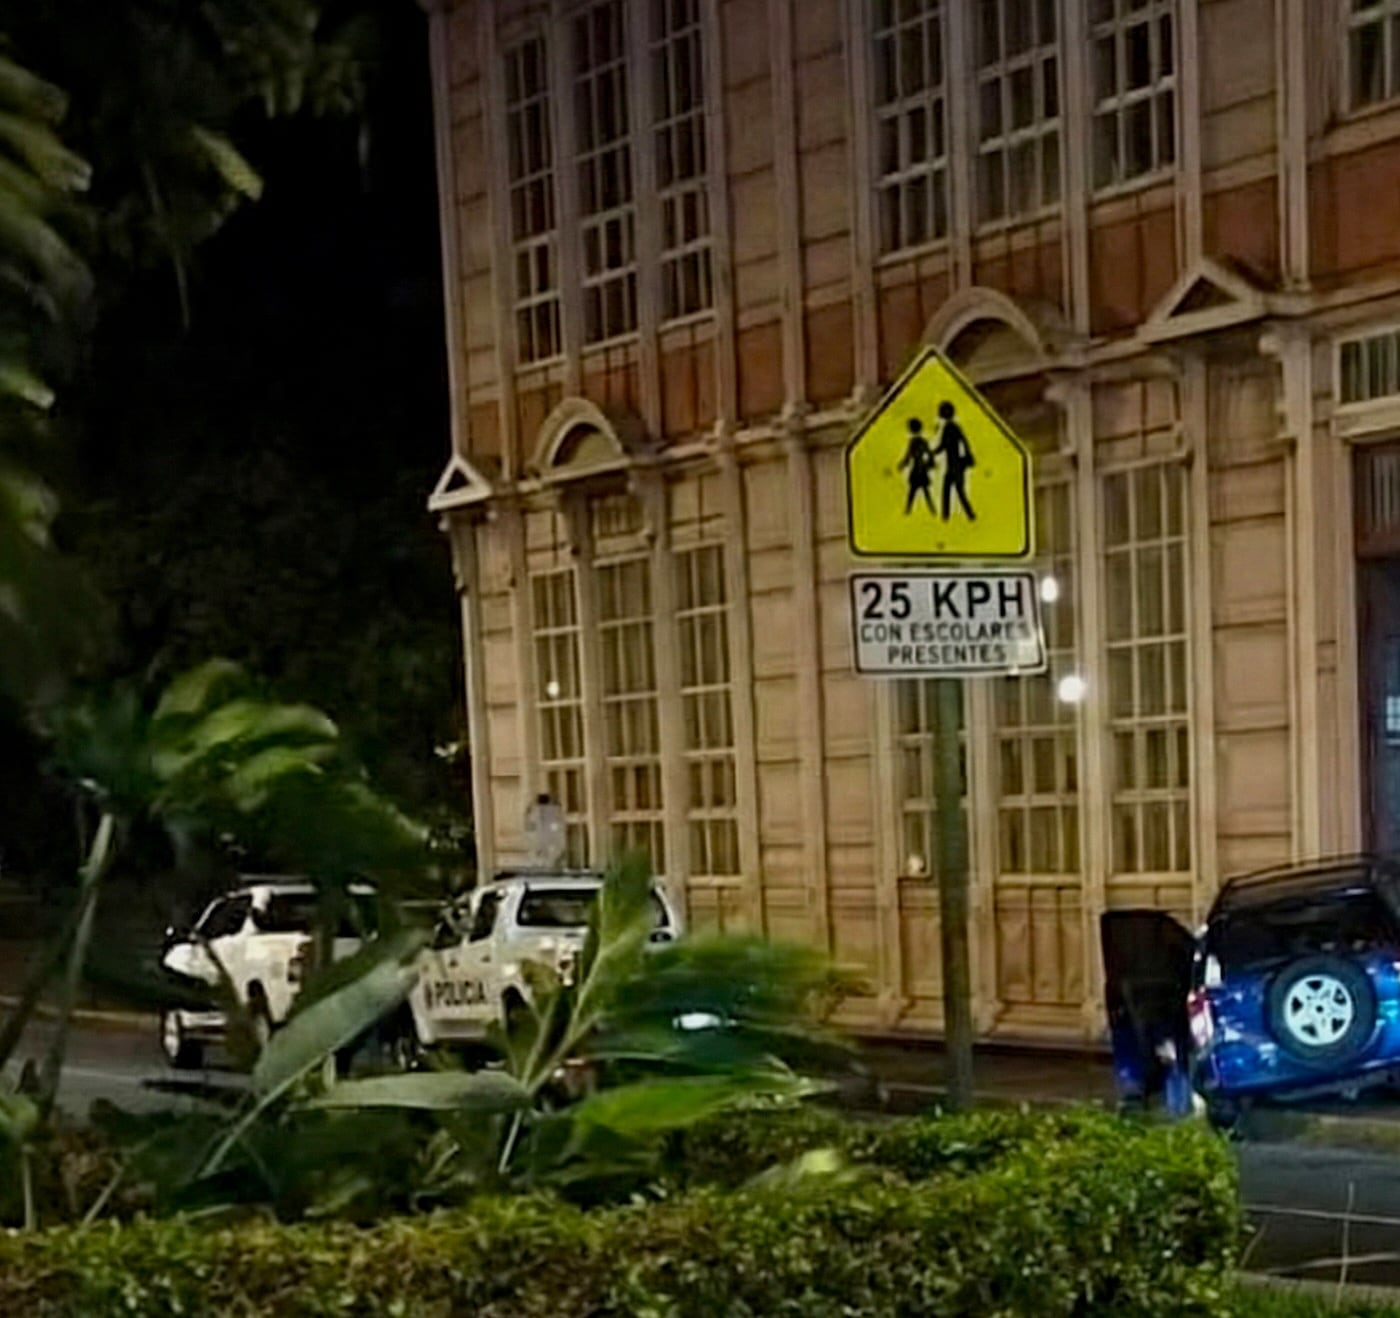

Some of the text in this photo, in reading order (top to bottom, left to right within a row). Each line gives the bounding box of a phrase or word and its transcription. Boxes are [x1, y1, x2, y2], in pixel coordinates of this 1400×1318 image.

[861, 580, 1024, 619] 25 KPH
[861, 621, 1030, 643] CON ESCOLARES
[888, 643, 1007, 665] PRESENTES
[434, 980, 488, 1007] POLICIA
